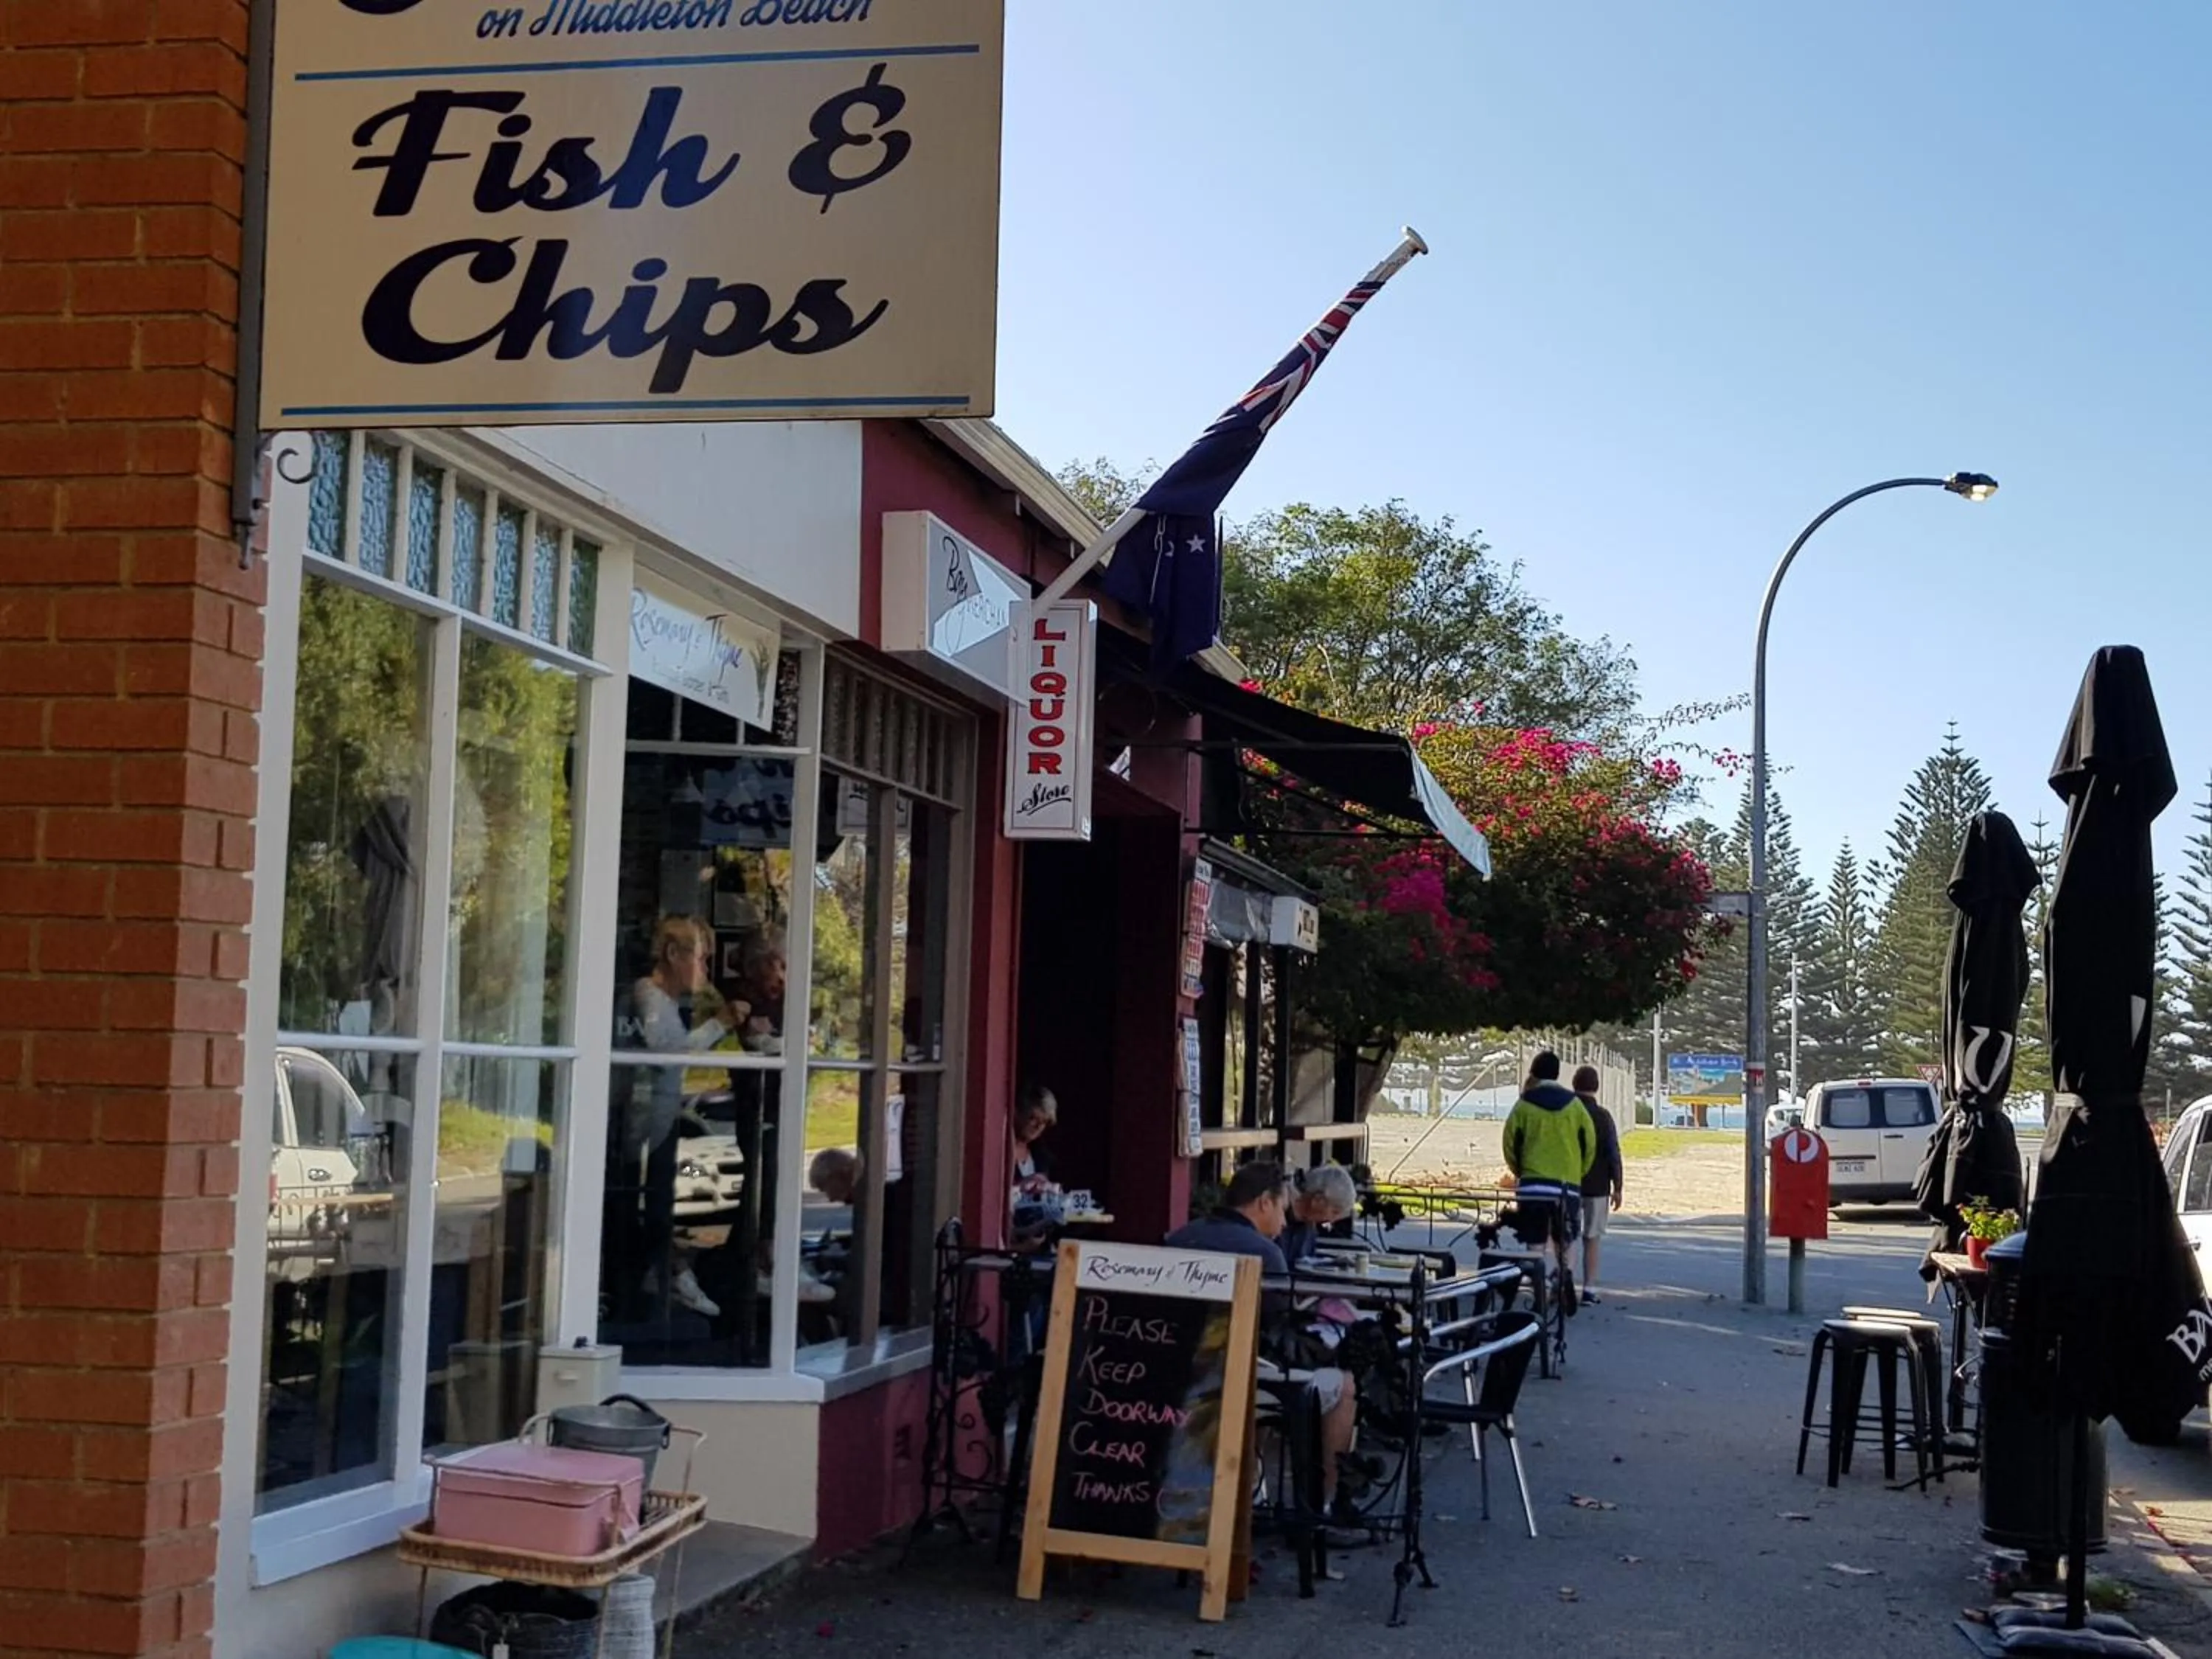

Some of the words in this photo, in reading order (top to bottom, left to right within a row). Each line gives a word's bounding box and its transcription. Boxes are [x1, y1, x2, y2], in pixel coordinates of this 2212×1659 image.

[476, 7, 524, 38] on
[351, 86, 740, 217] Fish
[787, 62, 912, 215] &
[361, 236, 888, 394] Chips
[1027, 618, 1066, 774] LIQUOR
[1017, 782, 1071, 816] Store
[1073, 1194, 1088, 1208] 32
[1087, 1255, 1164, 1284] Rosemary
[1179, 1257, 1228, 1290] Thyme
[1083, 1295, 1178, 1344] PLEASE
[1077, 1346, 1146, 1385] KEEP
[1079, 1387, 1192, 1427] DOORWAY
[1069, 1421, 1144, 1467] CLEAR
[1071, 1472, 1150, 1503] THANKS
